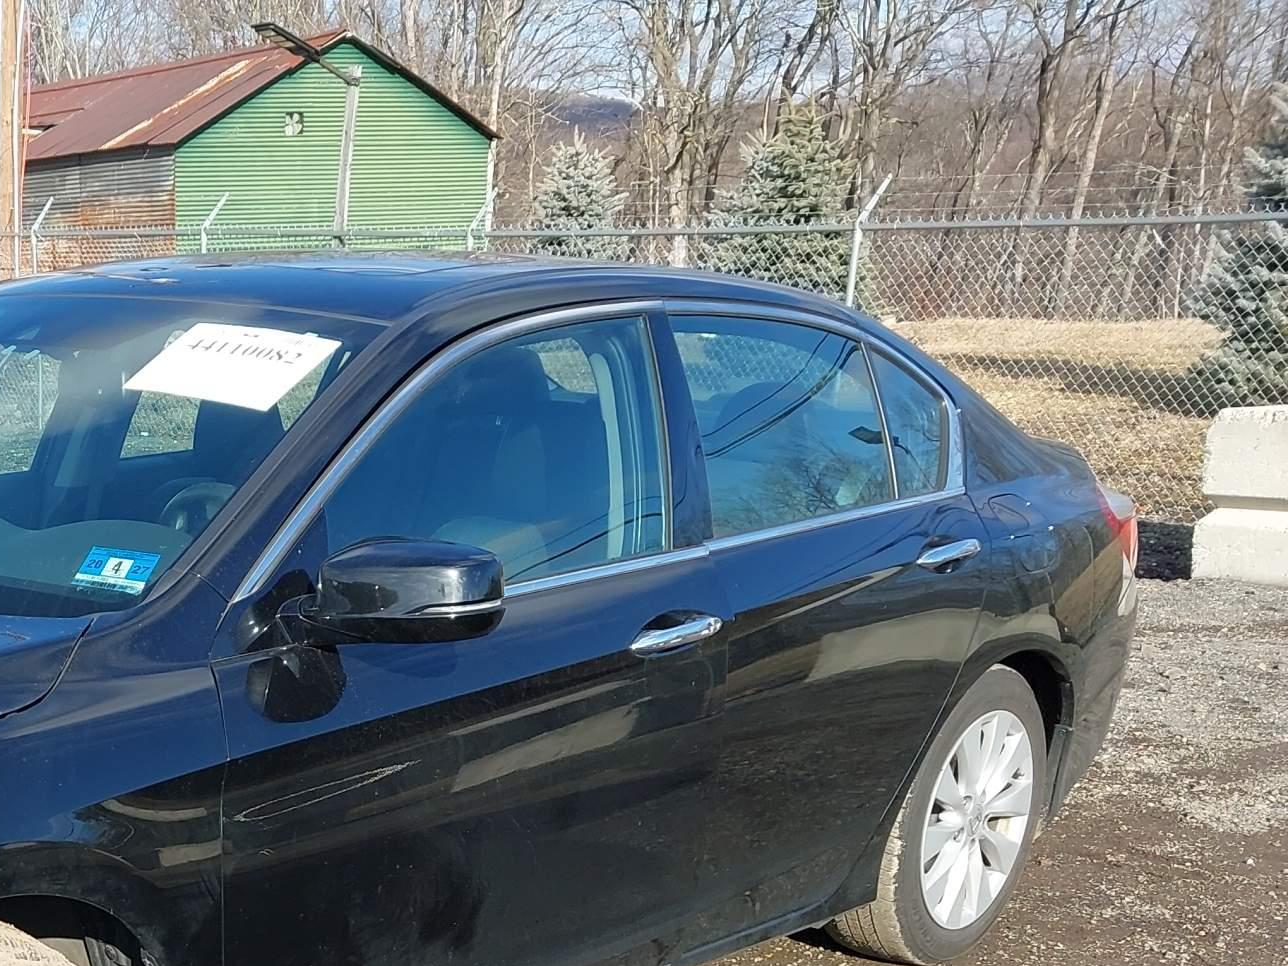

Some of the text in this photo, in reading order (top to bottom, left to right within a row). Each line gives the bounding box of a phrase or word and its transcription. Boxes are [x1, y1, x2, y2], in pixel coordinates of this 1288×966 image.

[186, 338, 303, 365] 44110082
[86, 559, 151, 575] 20 4 27
